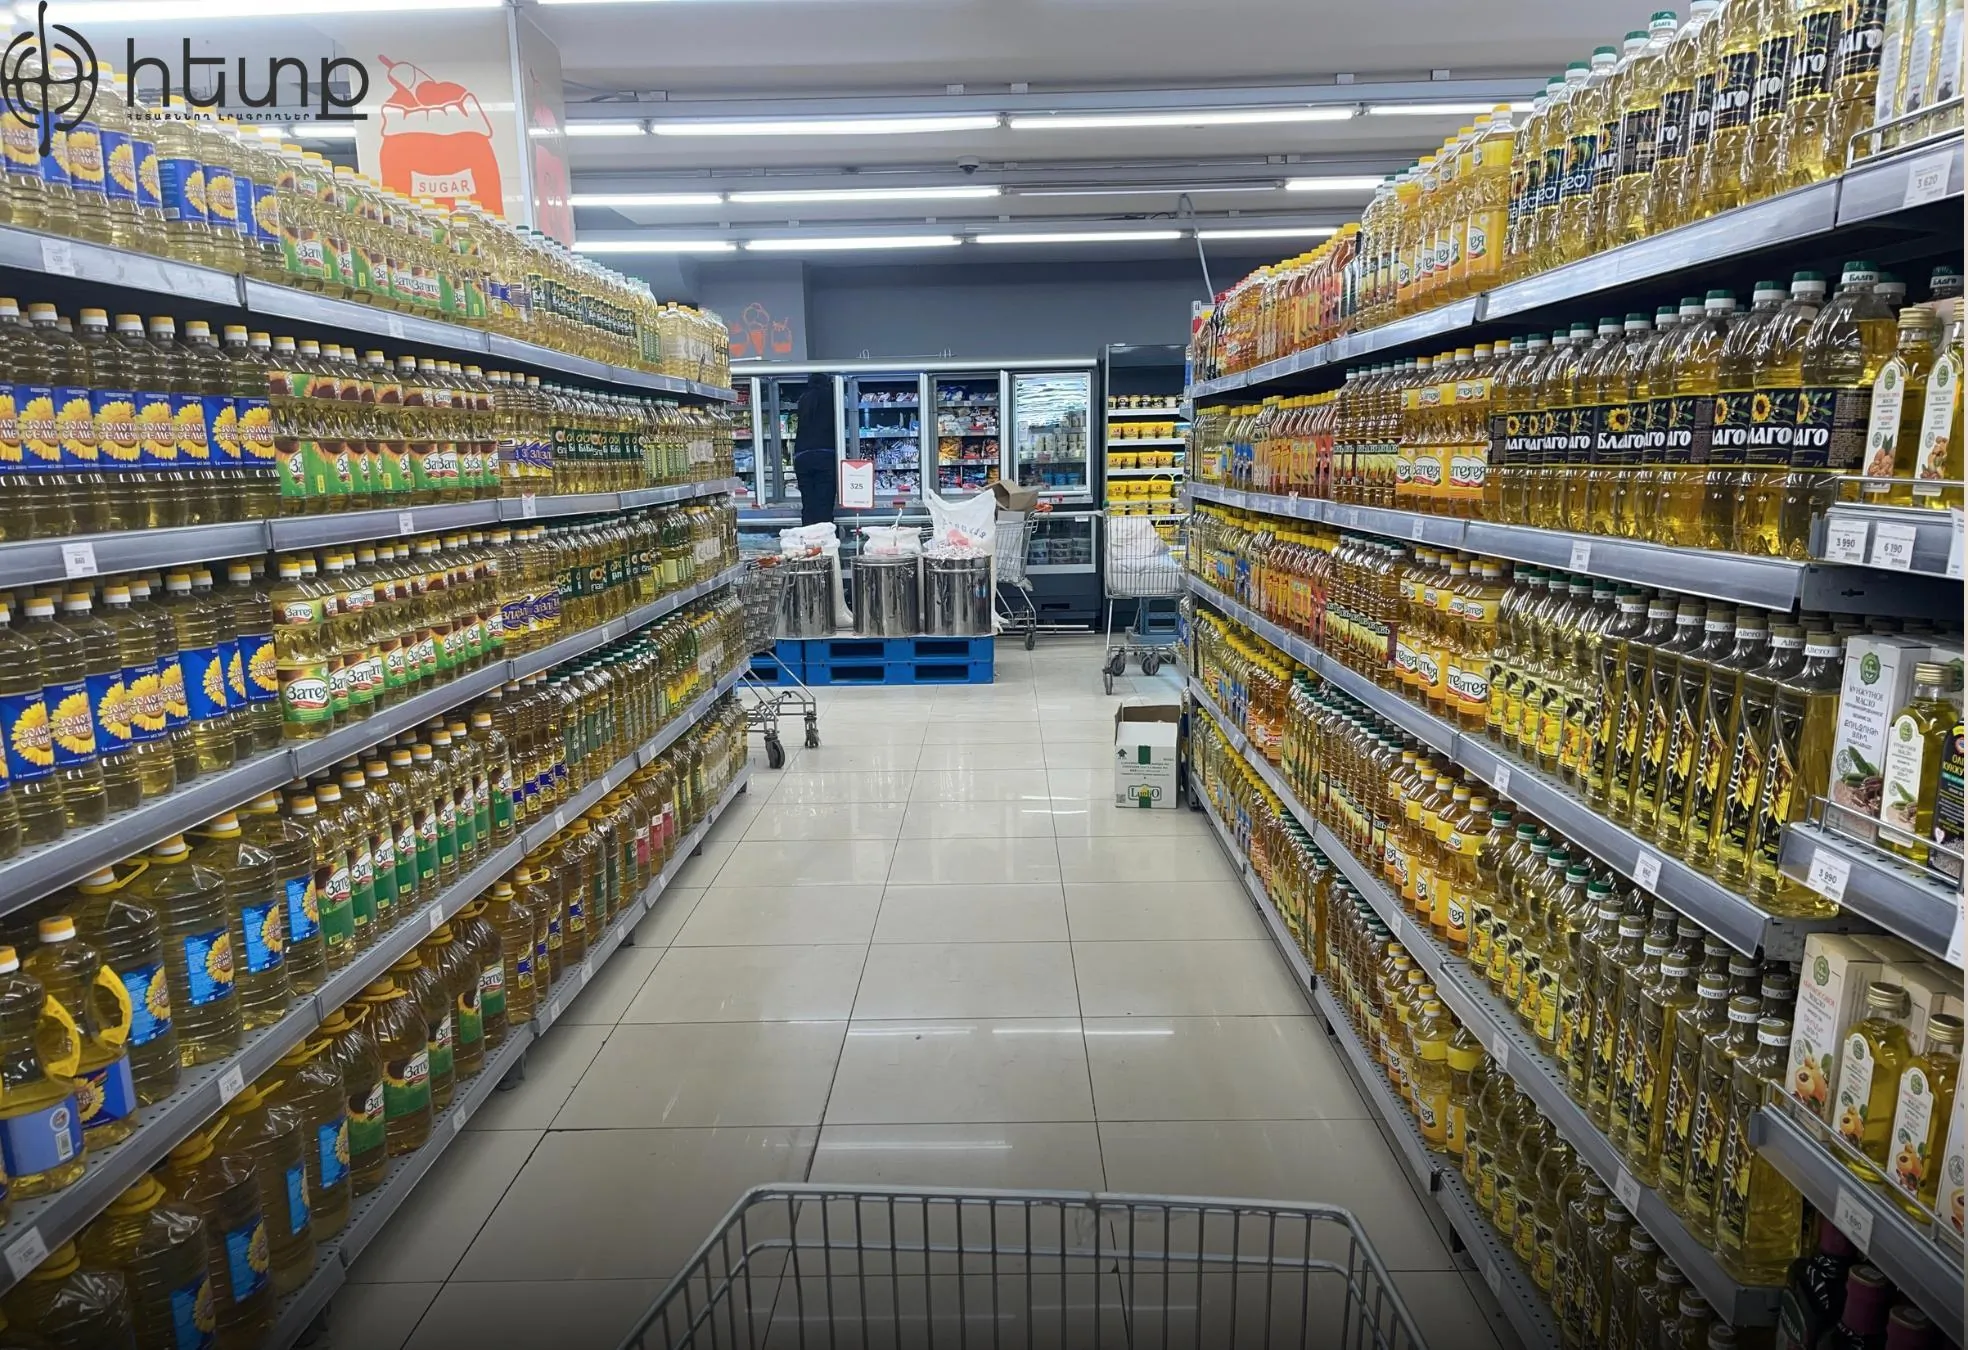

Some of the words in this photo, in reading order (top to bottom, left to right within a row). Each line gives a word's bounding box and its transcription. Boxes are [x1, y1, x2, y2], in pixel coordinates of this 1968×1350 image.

[418, 179, 471, 193] SUGAR
[1842, 538, 1856, 548] 990
[1890, 543, 1903, 554] 190
[1737, 628, 1761, 638] Altero
[286, 685, 328, 700] Затея
[1824, 871, 1838, 884] 990
